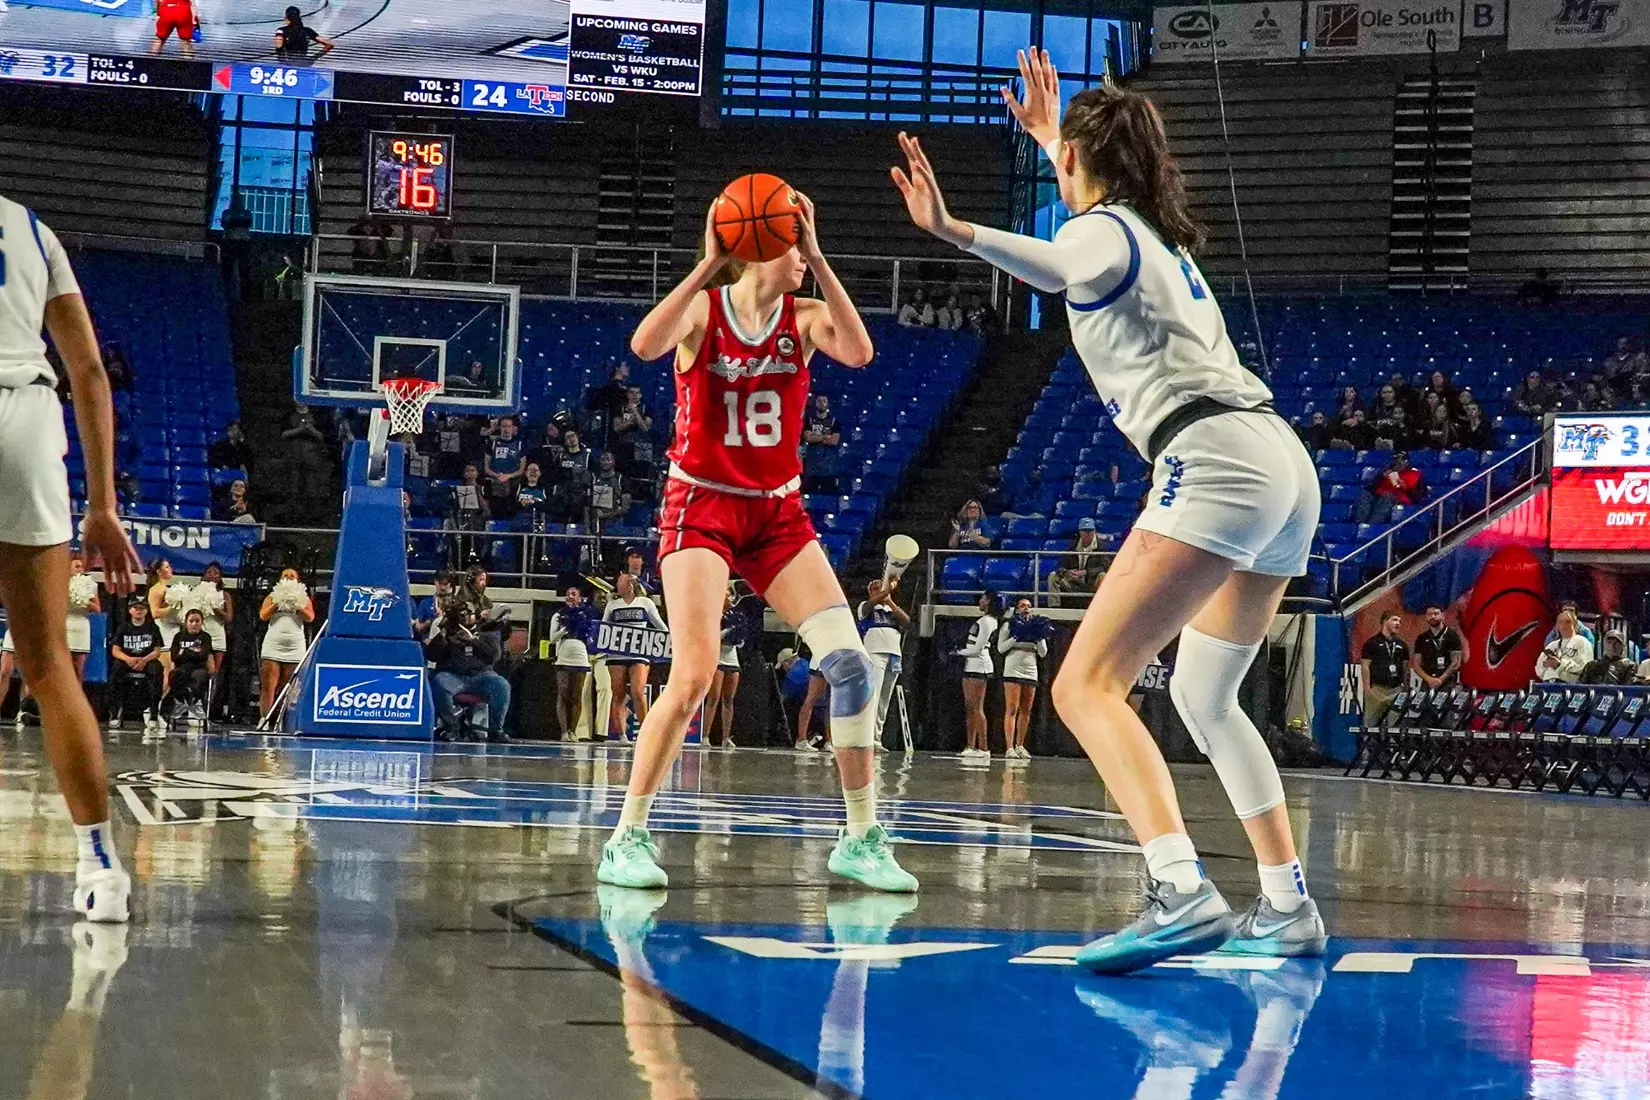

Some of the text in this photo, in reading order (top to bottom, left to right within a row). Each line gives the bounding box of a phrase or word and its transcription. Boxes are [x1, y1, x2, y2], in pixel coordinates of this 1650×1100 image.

[576, 17, 697, 35] UPCOMING GAMES
[1361, 7, 1455, 27] Ole South
[1473, 4, 1494, 28] B
[42, 55, 75, 78] 32
[91, 58, 115, 69] TOL
[125, 61, 134, 71] 4
[571, 50, 699, 68] WOMEN'S BASKETBALL
[90, 70, 130, 82] FOULS
[139, 73, 149, 84] 0
[250, 67, 298, 88] 9:46
[612, 64, 657, 76] VS WKU
[262, 85, 284, 95] 3RD
[419, 79, 443, 91] TOL
[451, 83, 460, 92] 3
[573, 74, 596, 83] SAT
[604, 77, 629, 86] FEB.
[632, 78, 644, 87] 15
[653, 80, 695, 91] 2:00PM
[403, 91, 442, 103] FOULS
[451, 94, 460, 105] 0
[472, 84, 508, 107] 24
[566, 90, 615, 103] SECOND
[393, 140, 444, 166] 9:46
[400, 167, 437, 208] 16
[723, 389, 782, 447] 18
[1557, 427, 1607, 460] MT
[1620, 424, 1650, 457] 3
[1606, 511, 1648, 526] DON'T
[343, 588, 392, 621] MT
[596, 624, 673, 659] DEFENSE
[319, 685, 415, 710] Ascend
[318, 707, 411, 719] Federal Credit Union
